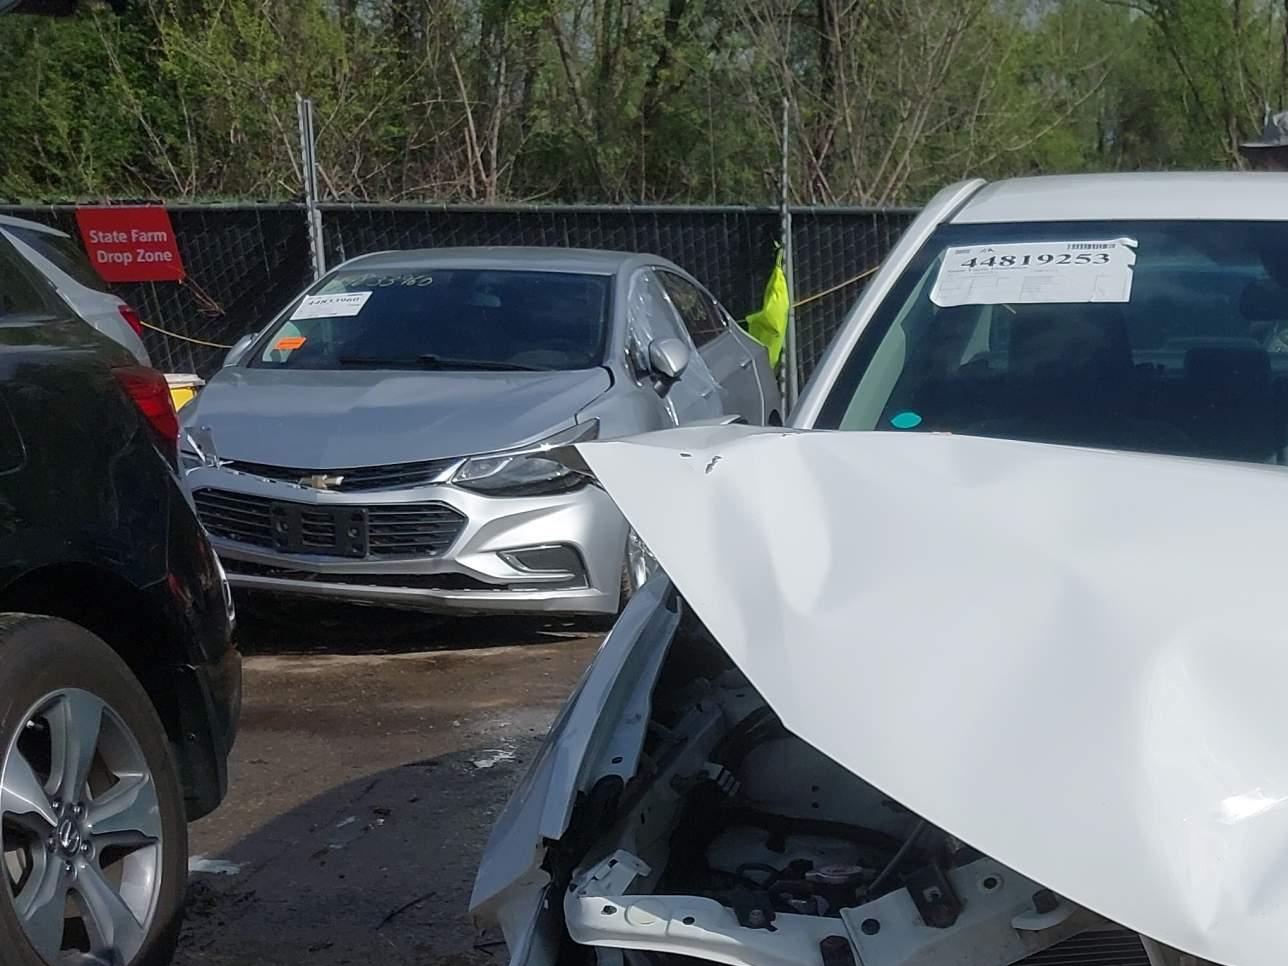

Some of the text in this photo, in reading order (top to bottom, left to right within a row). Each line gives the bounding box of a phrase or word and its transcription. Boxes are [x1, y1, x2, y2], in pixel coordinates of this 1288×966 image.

[88, 229, 167, 243] State Farm
[96, 249, 172, 266] Drop Zone
[960, 253, 1111, 268] 44819253
